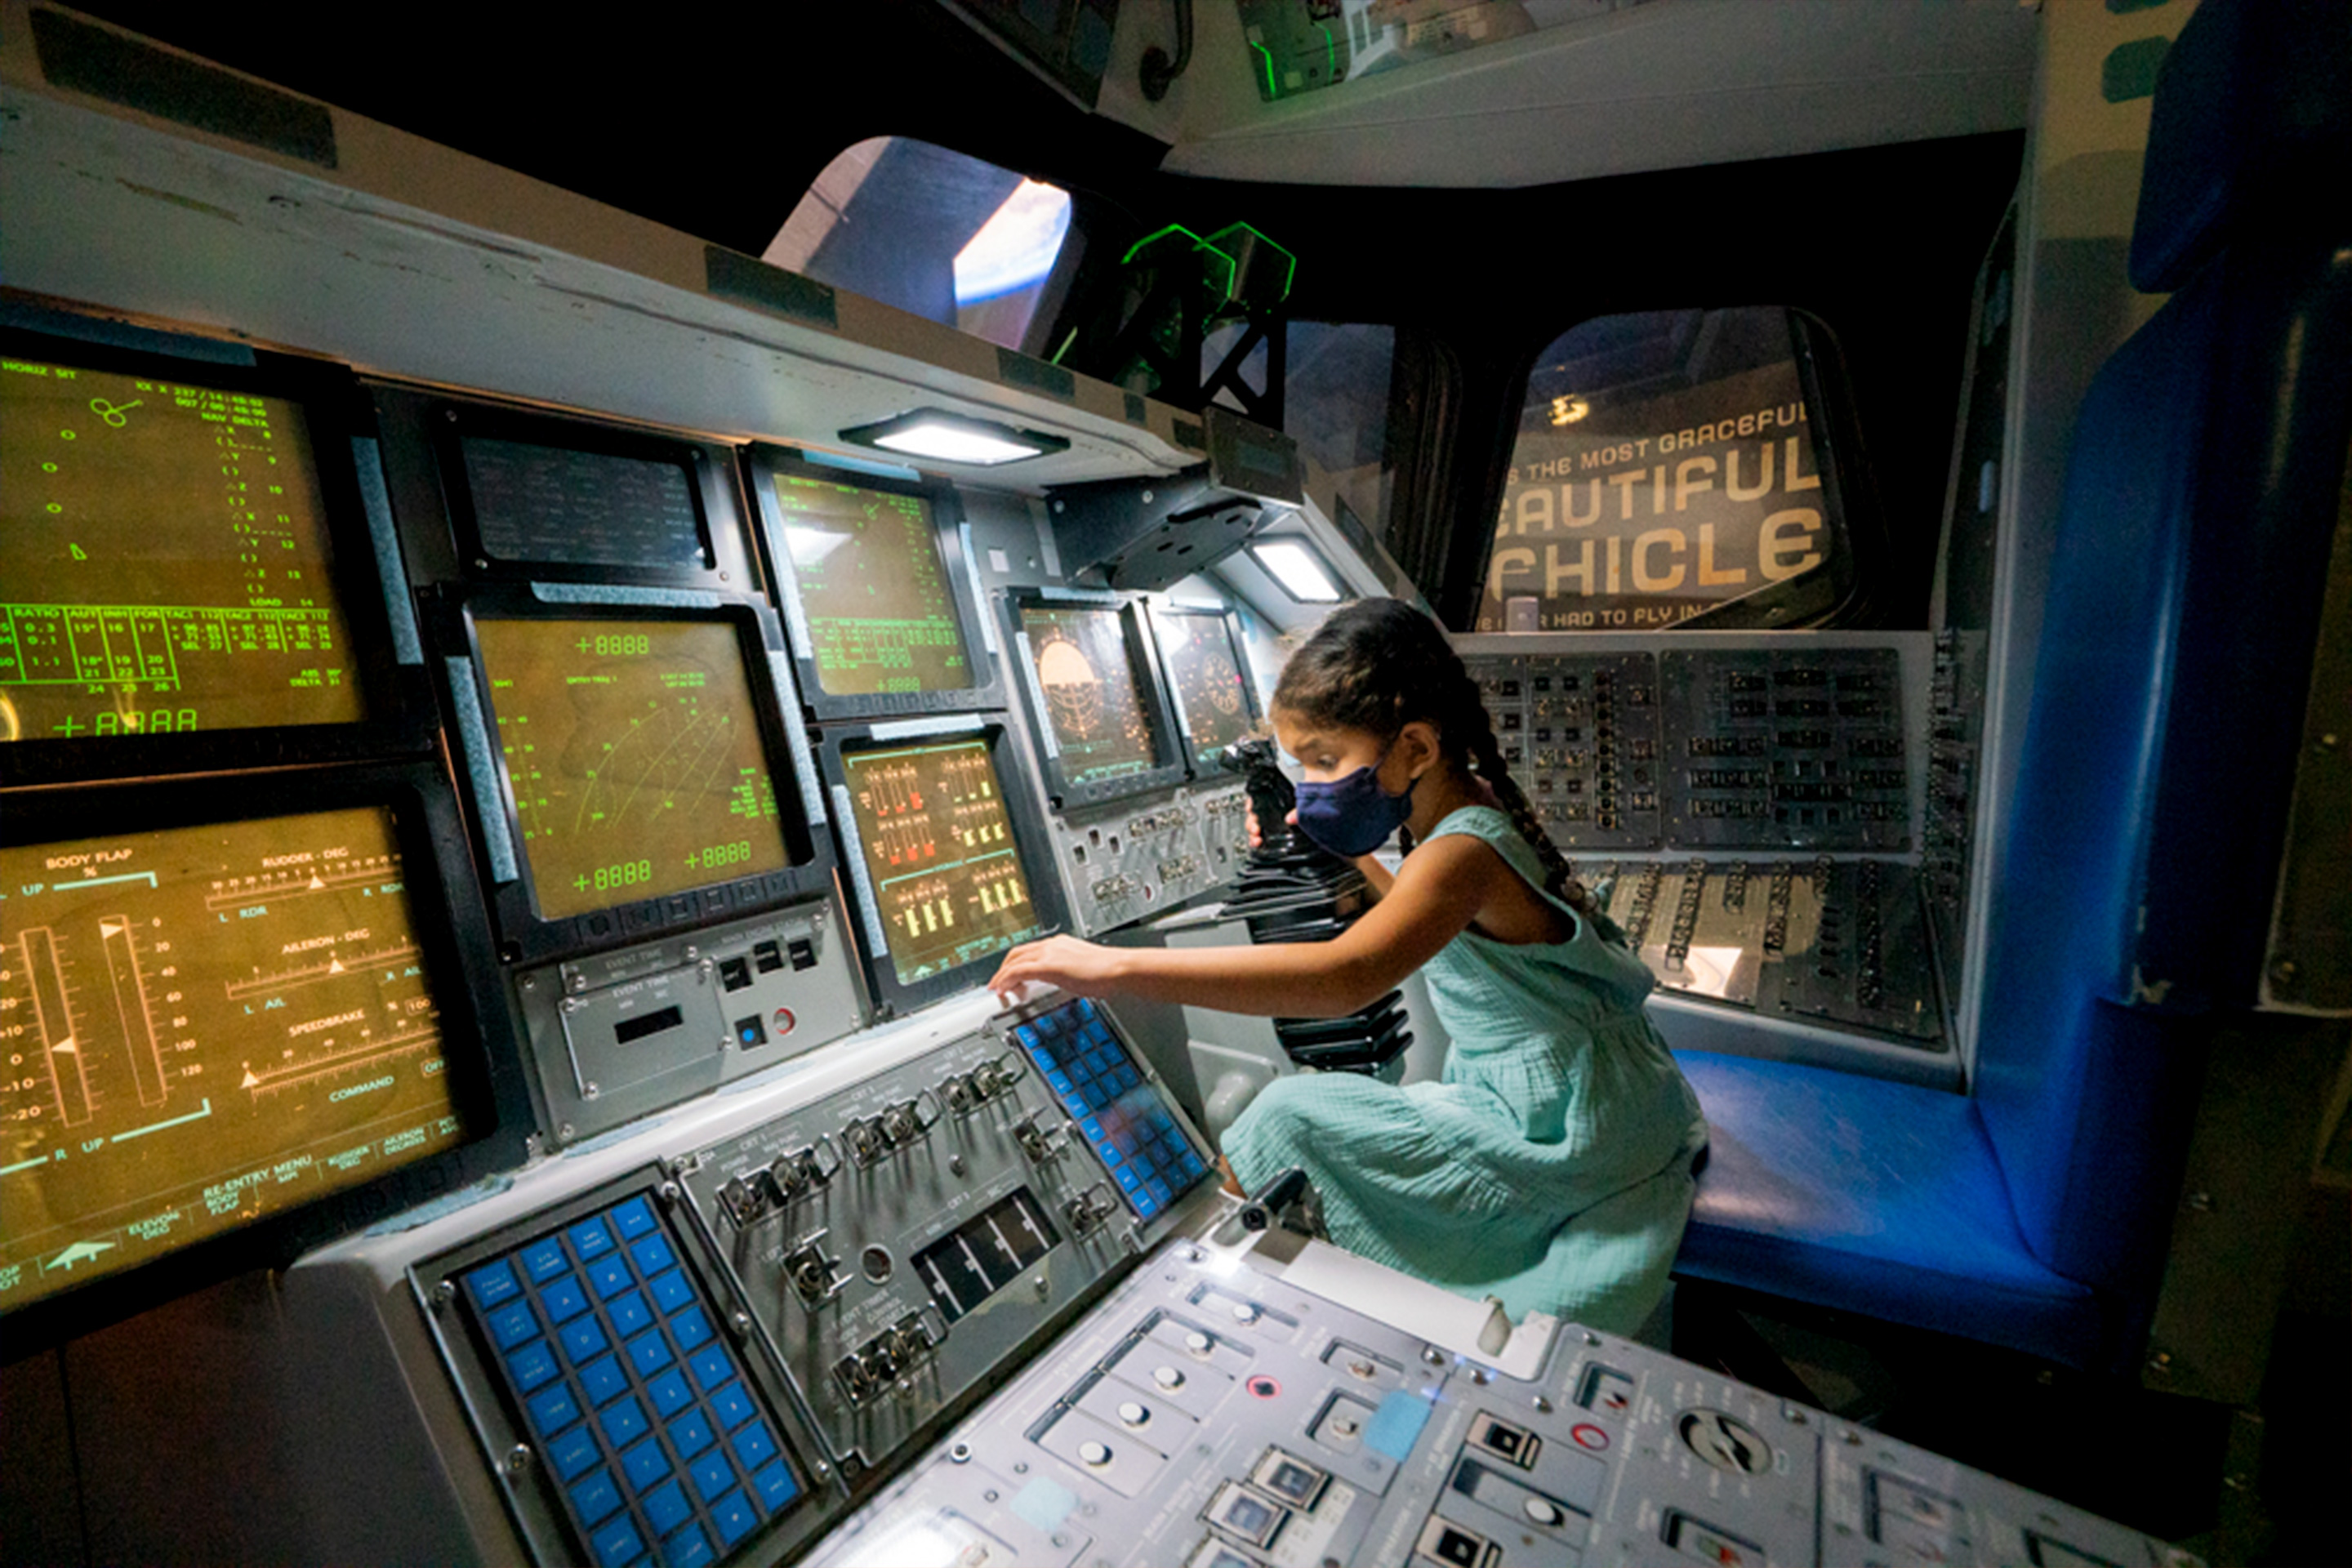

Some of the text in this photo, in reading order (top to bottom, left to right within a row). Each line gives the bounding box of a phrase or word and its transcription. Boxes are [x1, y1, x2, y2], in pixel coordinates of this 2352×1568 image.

[232, 415, 270, 428] DELTA
[1527, 457, 1572, 480] THE
[1580, 439, 1650, 471] MOST
[248, 596, 283, 608] LOAD
[13, 608, 61, 620] RATIO
[69, 608, 97, 619] AUT
[134, 609, 162, 620] FOR
[1553, 611, 1595, 628] HAD
[1601, 609, 1627, 626] TO
[1633, 607, 1672, 624] FLY
[140, 622, 155, 632] 17
[147, 654, 163, 664] 20
[87, 683, 105, 694] 24
[289, 677, 323, 688] DELTA
[46, 849, 133, 870] BODY FLAP
[261, 846, 350, 868] RUDDER DEG
[83, 866, 97, 878] %
[21, 883, 44, 897] UP
[218, 905, 268, 924] L RDR
[152, 917, 162, 928] 0
[155, 941, 171, 953] 20
[282, 928, 371, 955] AILERON DEG
[403, 966, 422, 978] AIL
[166, 991, 183, 1003] 60
[612, 982, 644, 999] EVENT
[244, 996, 286, 1015] L AIL
[409, 997, 433, 1011] 100
[288, 1008, 366, 1038] SPEEDBRAKE
[175, 1038, 197, 1052] 100
[10, 1053, 23, 1066] 0
[180, 1063, 203, 1077] 120
[424, 1060, 445, 1074] OFF
[328, 1075, 394, 1103] COMMAND
[55, 1137, 105, 1160] R UP
[338, 1156, 361, 1170] DEG
[203, 1153, 314, 1198] RE-ENTRY MENU
[206, 1190, 239, 1209] BODY
[210, 1199, 240, 1216] FLAP
[127, 1210, 180, 1236] ELEVON
[142, 1224, 170, 1241] DEG
